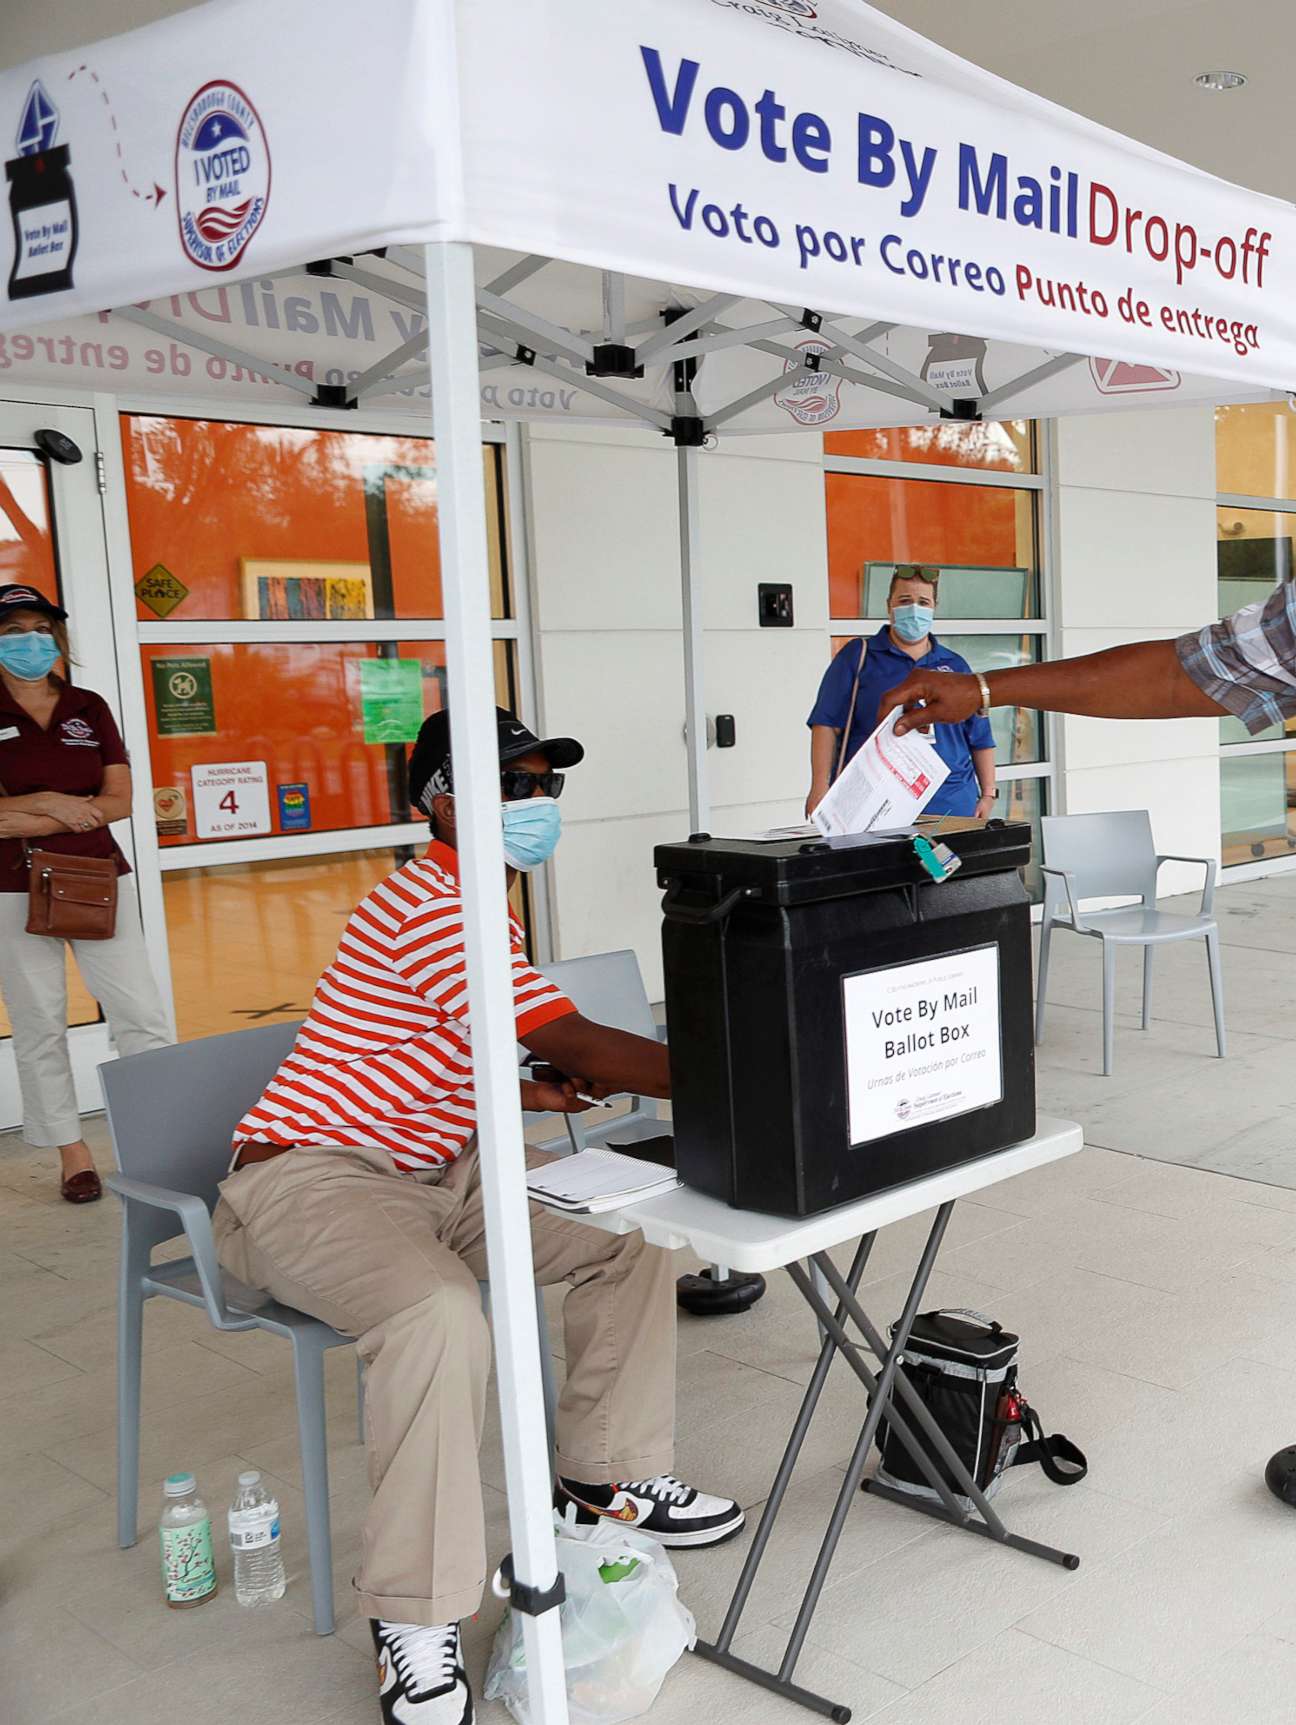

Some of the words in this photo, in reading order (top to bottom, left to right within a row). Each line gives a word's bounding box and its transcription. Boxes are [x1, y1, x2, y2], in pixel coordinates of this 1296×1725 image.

[193, 159, 200, 186] I
[200, 145, 251, 184] VOTED
[640, 45, 833, 174] Vote
[857, 112, 938, 218] By
[958, 142, 1079, 239] Mail
[1089, 181, 1272, 288] Drop-off
[206, 186, 219, 203] BY
[219, 179, 241, 200] MAIL
[227, 197, 264, 256] ELECTIONS
[668, 183, 780, 249] Voto
[795, 224, 866, 269] por
[880, 234, 1006, 296] Correo
[1015, 263, 1109, 319] Punto
[1117, 287, 1153, 328] de
[1160, 305, 1261, 356] entrega
[147, 578, 174, 588] SAFE
[197, 778, 236, 787] CATEGORY
[238, 776, 263, 784] RATING
[207, 767, 252, 777] HURRICANE
[219, 790, 239, 814] 4
[224, 824, 235, 832] OF
[238, 822, 258, 831] 2014
[872, 1007, 912, 1029] Vote
[918, 1000, 938, 1020] By
[943, 986, 977, 1011] Mail
[885, 1032, 935, 1059] Ballot
[940, 1024, 970, 1044] Box
[867, 1073, 894, 1090] Urnas
[895, 1070, 906, 1082] de
[944, 1056, 959, 1071] por
[960, 1049, 986, 1064] Correo
